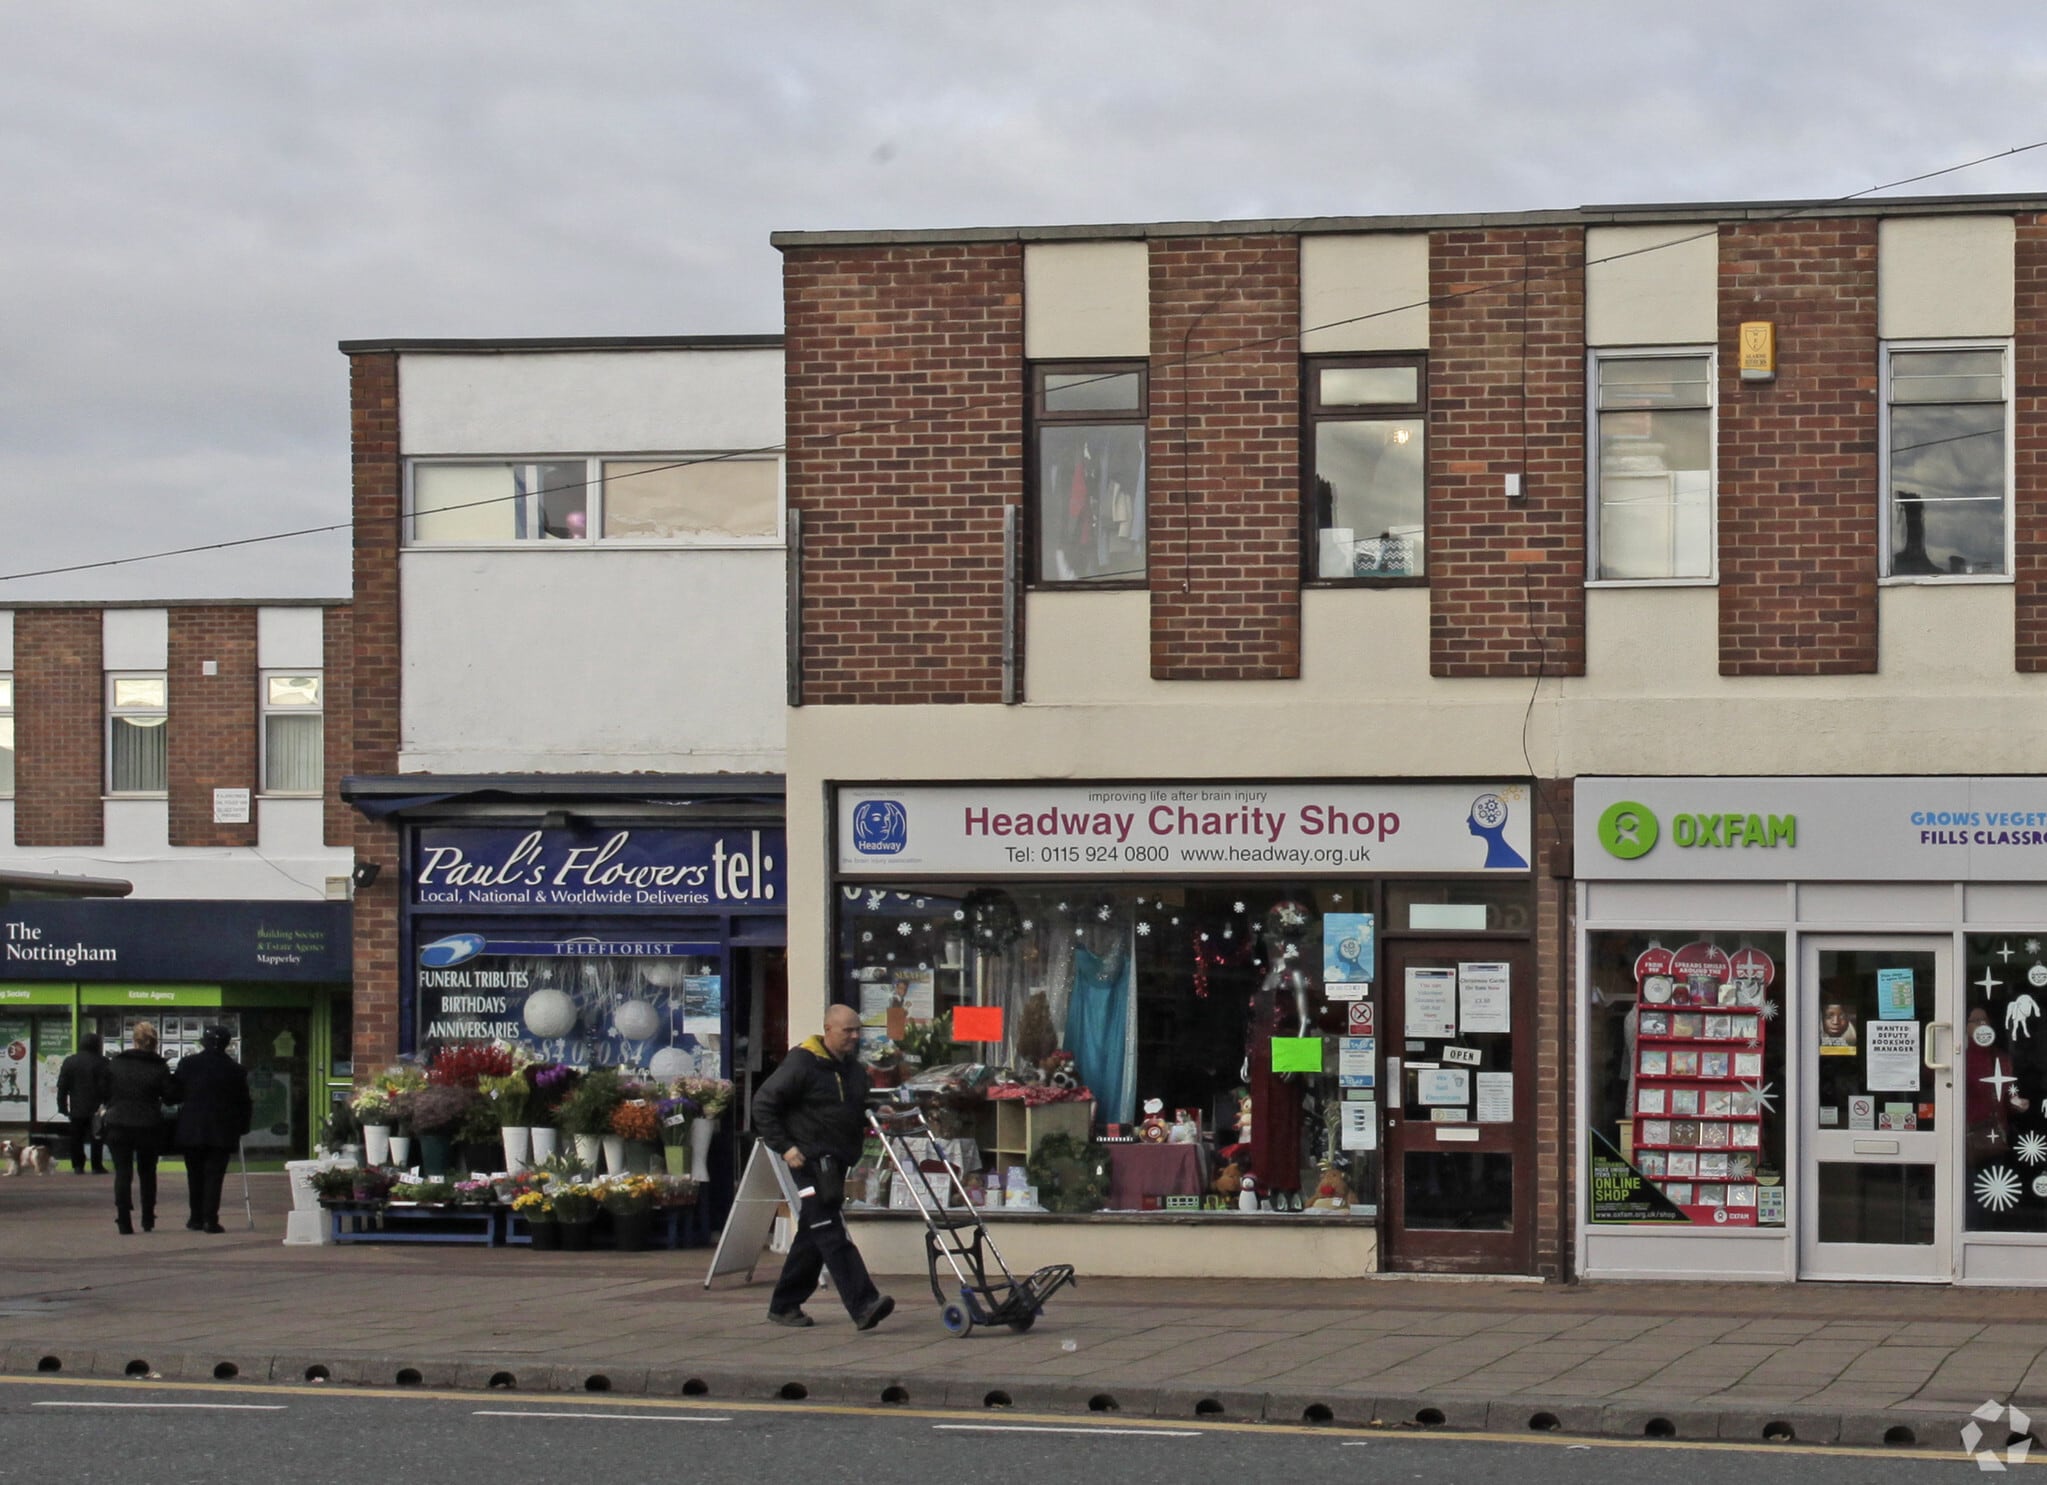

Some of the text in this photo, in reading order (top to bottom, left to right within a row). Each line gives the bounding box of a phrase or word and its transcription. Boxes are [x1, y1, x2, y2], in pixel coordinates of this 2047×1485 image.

[1088, 790, 1267, 803] improving life after brain injury
[964, 804, 1401, 843] Headway Charity Shop
[1910, 812, 1980, 827] GROWS
[1672, 813, 1797, 848] OXFAM
[1920, 830, 1969, 845] FILLS
[858, 840, 902, 853] Headway
[1005, 845, 1371, 866] Tel: 0115 924 0800 www.headway.org.uk
[418, 830, 774, 899] Paul's Flowers tel:
[420, 889, 709, 904] Local, National & Worldwide Deliveries
[6, 921, 41, 940] The
[6, 942, 117, 966] Nottingham
[553, 943, 675, 955] TELEFLORIST
[420, 971, 529, 988] FUNERAL TRIBUTES
[441, 996, 507, 1013] BIRTHDAYS
[428, 1022, 520, 1039] ANNIVERSARIES
[1450, 1049, 1474, 1061] OPEN
[1595, 1177, 1641, 1189] ONLINE
[1595, 1189, 1630, 1201] SHOP
